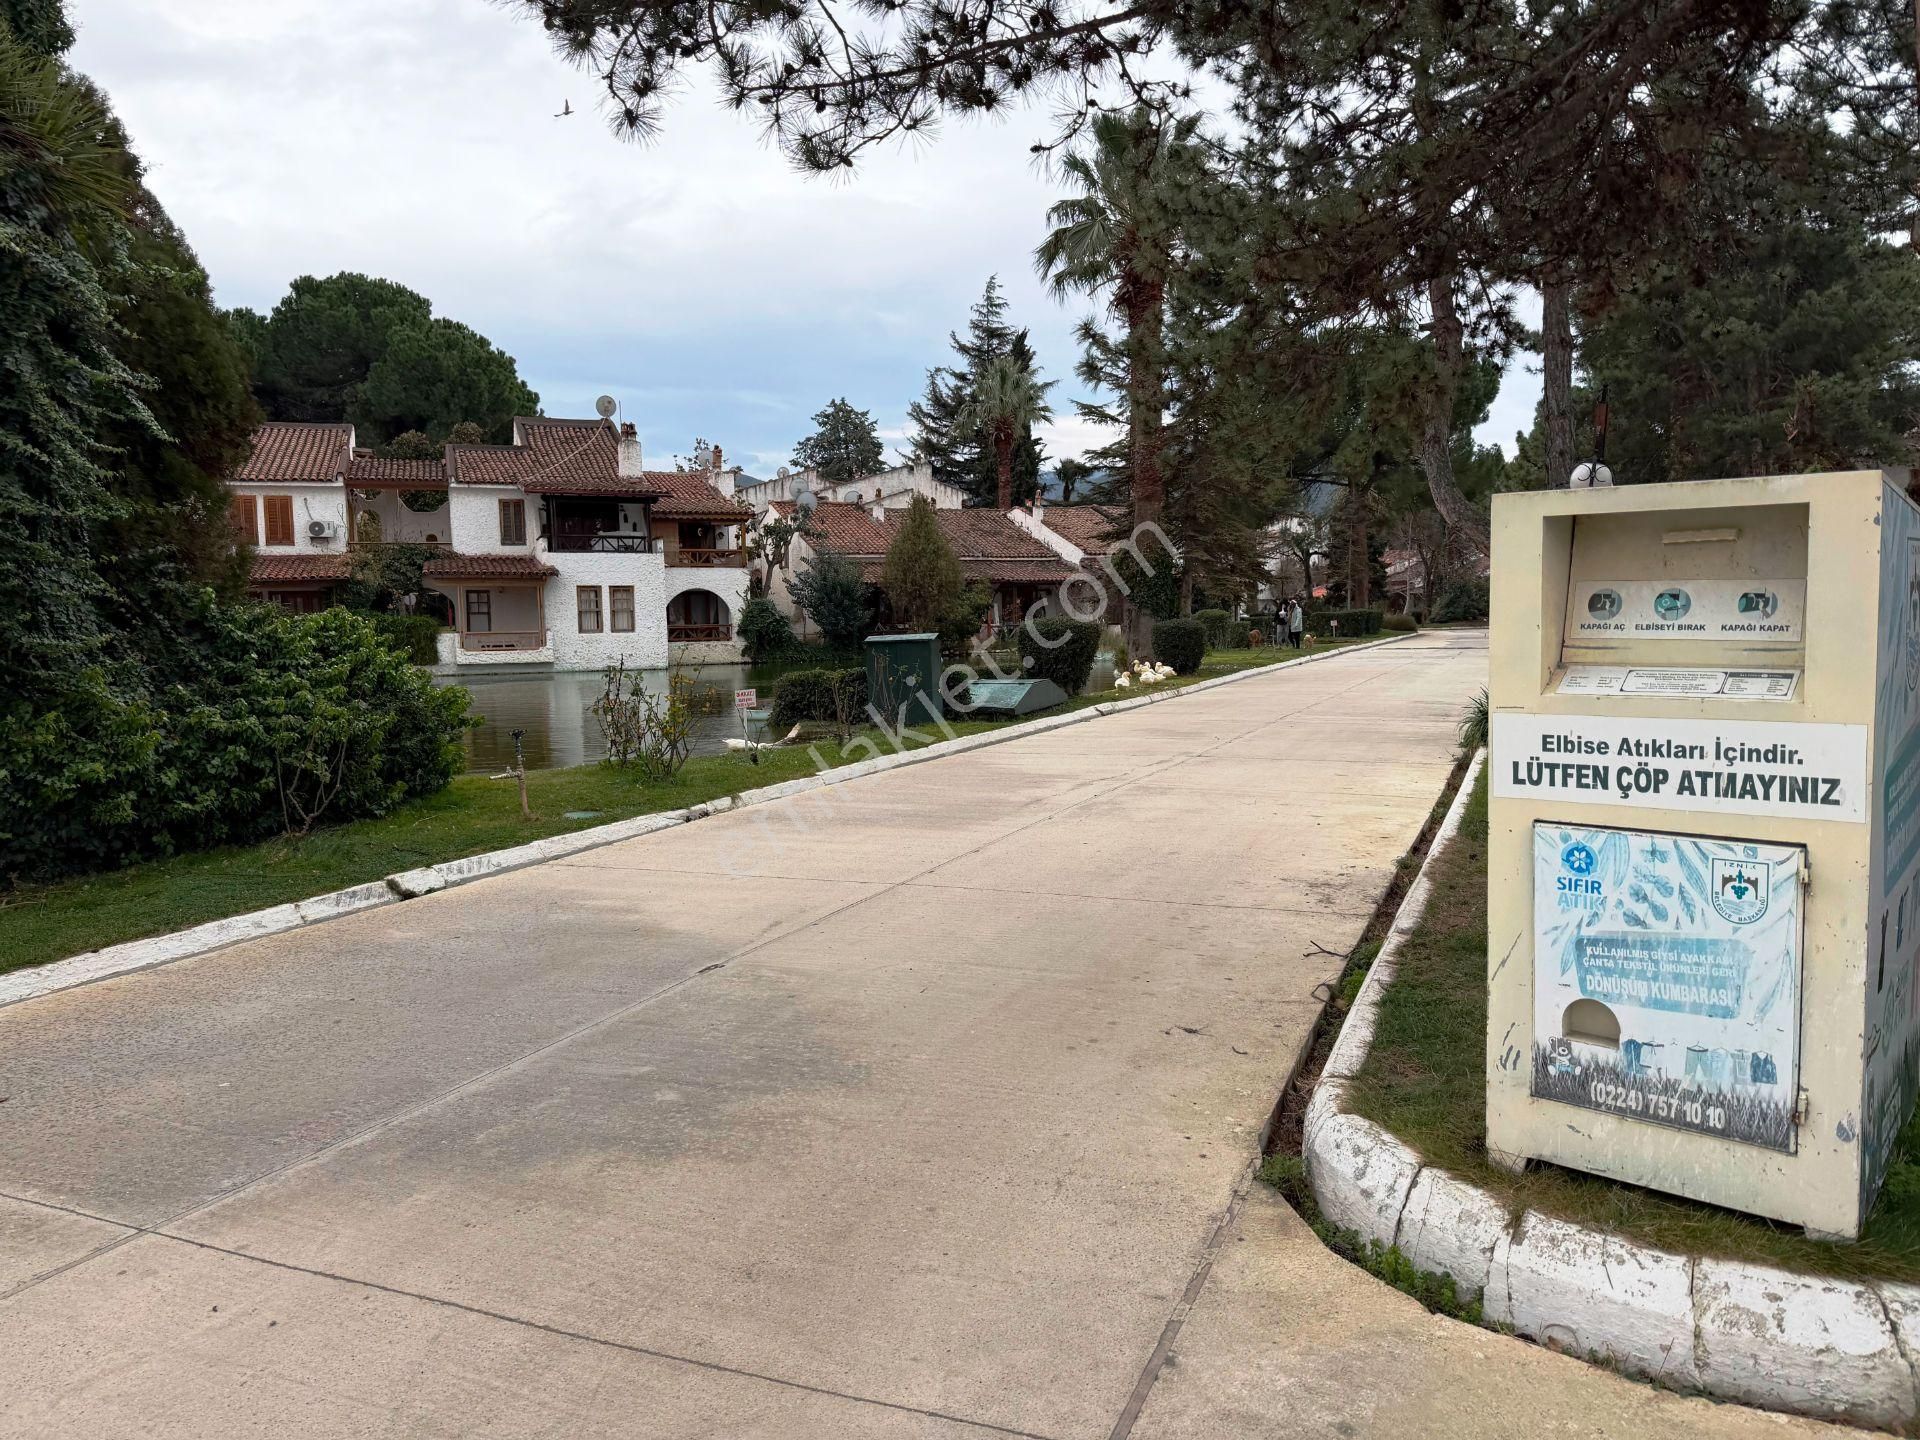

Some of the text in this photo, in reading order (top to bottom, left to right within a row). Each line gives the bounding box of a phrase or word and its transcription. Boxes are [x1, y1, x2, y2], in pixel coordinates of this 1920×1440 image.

[1580, 623, 1626, 632] KAPAĞI AÇ
[1634, 622, 1706, 632] ELBİSEYİ BIRAK
[1720, 623, 1791, 633] KAPAĞI KAPAT
[1541, 734, 1804, 767] Elbise Atıkları İçindir.
[1512, 756, 1842, 806] LÜTFEN ÇÖP ATMAYINIZ
[1556, 876, 1602, 896] SIFIR
[1582, 957, 1615, 968] ÇANTA
[1585, 972, 1732, 1006] DÖNÜŞÜM KUMBARASI
[1591, 1081, 1726, 1129] (0224) 757 10 10
